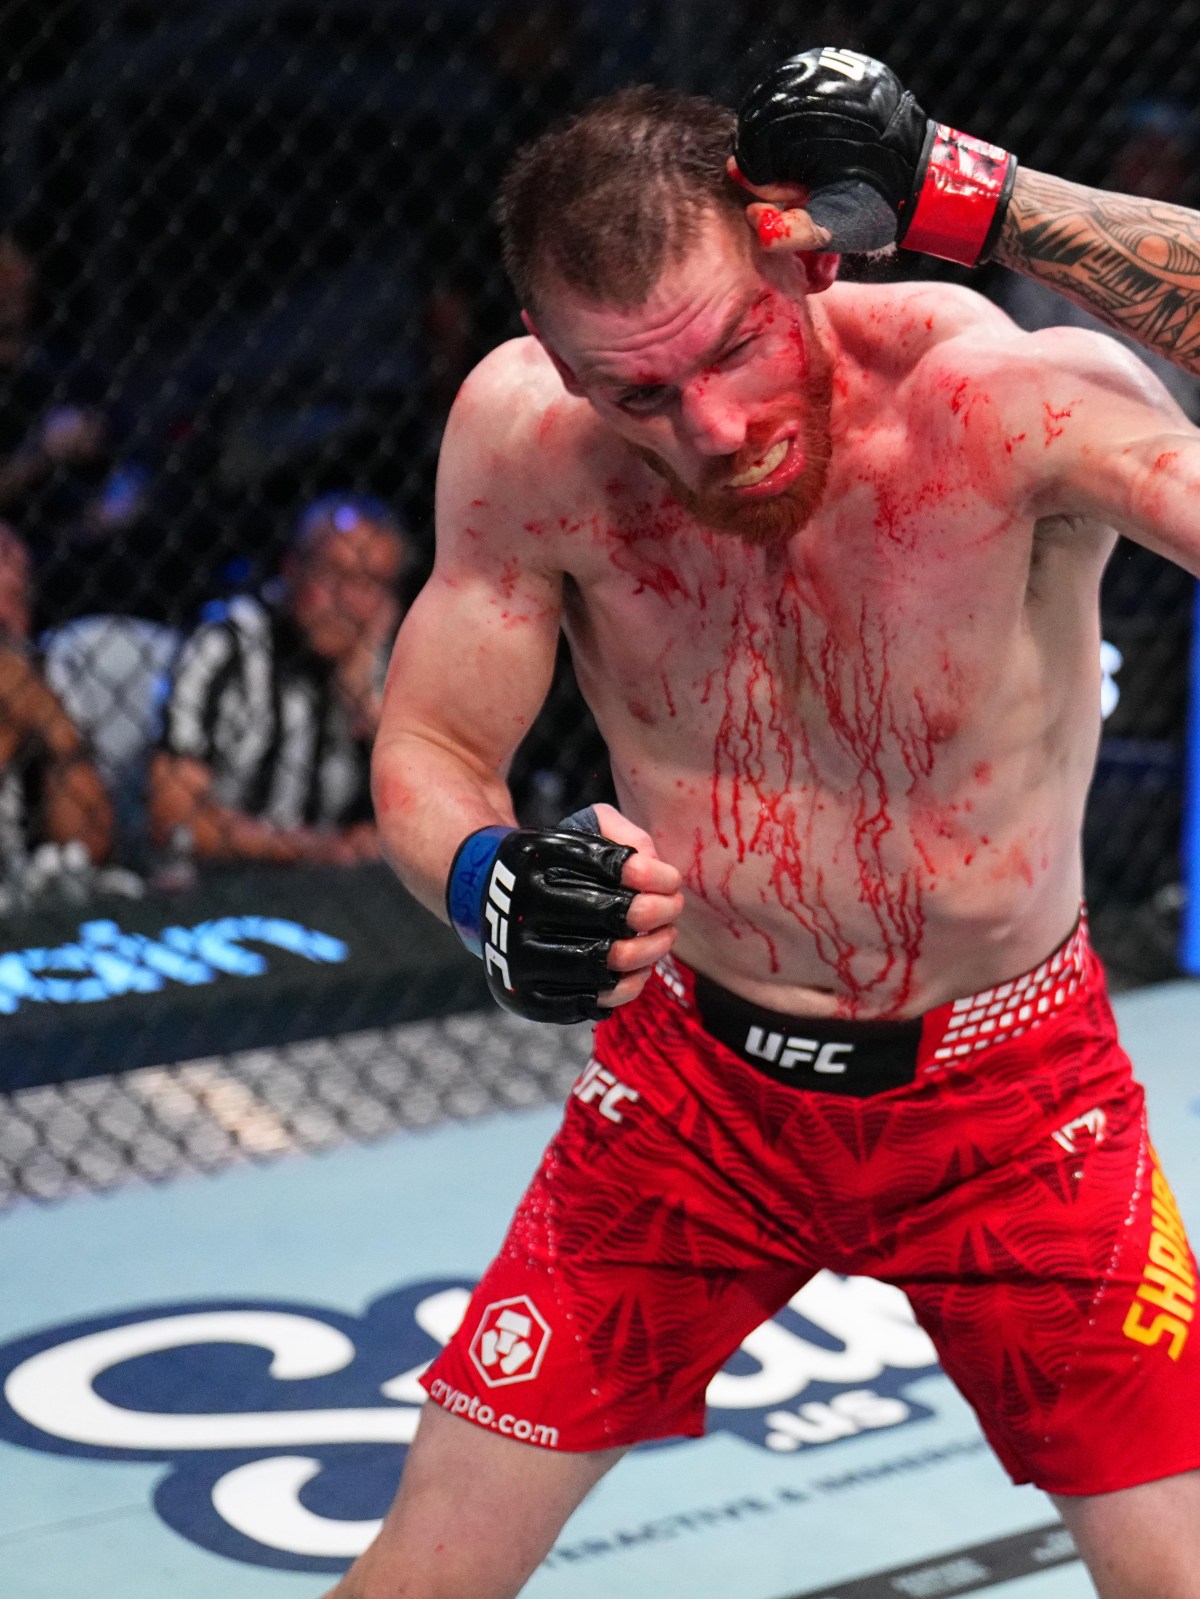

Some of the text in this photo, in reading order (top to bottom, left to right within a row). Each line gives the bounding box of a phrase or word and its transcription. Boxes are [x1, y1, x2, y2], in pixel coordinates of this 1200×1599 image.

[484, 859, 517, 991] UFC
[744, 1025, 855, 1074] UFC
[430, 1378, 560, 1447] crypto.com
